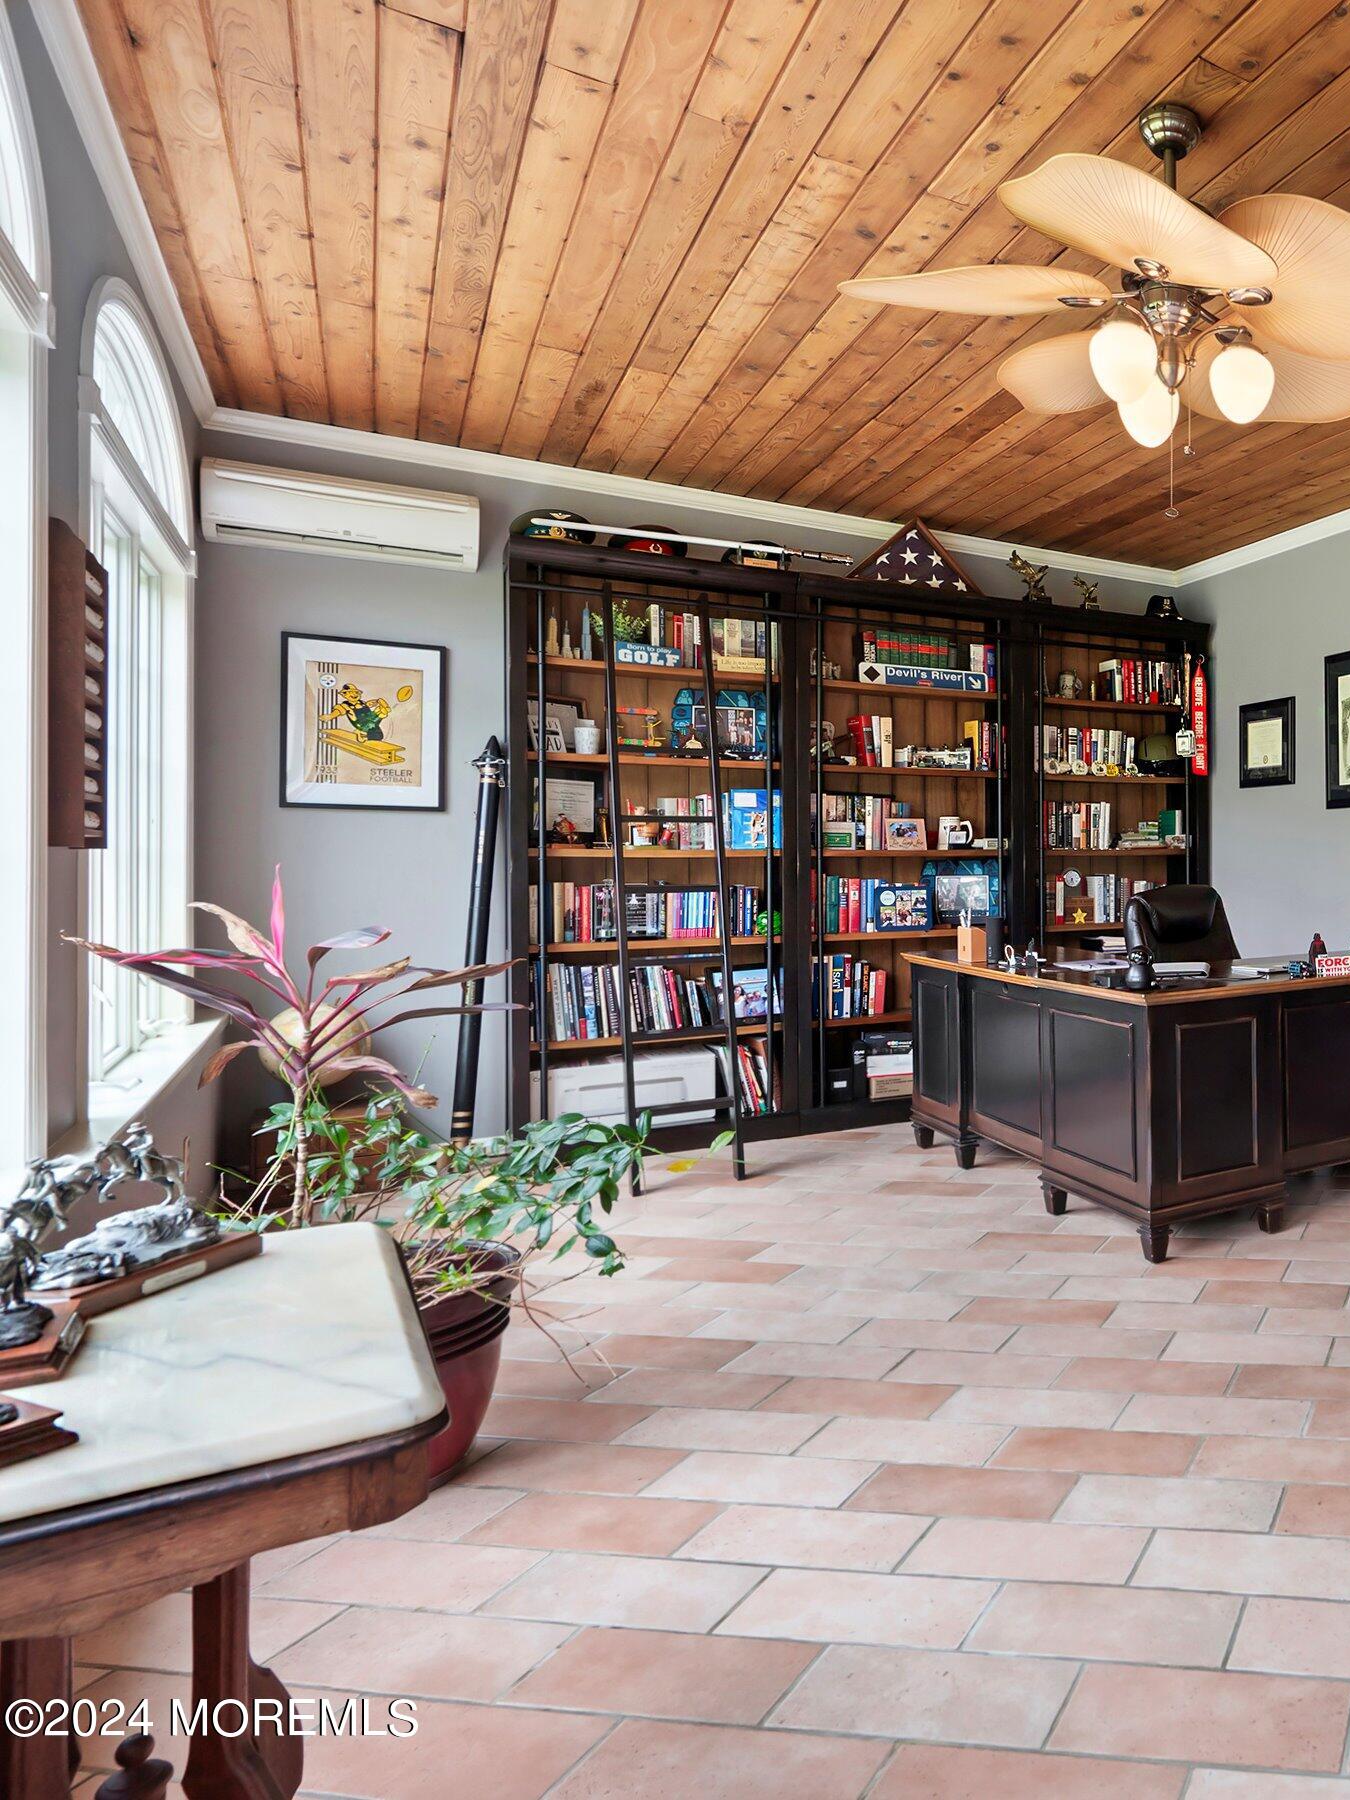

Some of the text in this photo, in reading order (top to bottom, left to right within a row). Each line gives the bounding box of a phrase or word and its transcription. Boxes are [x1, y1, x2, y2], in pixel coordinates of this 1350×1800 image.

[618, 649, 680, 666] GOLF
[887, 667, 962, 682] Devil's River
[1195, 677, 1205, 770] REMOVE BEFORE FLIGHT
[370, 768, 412, 777] STEELER
